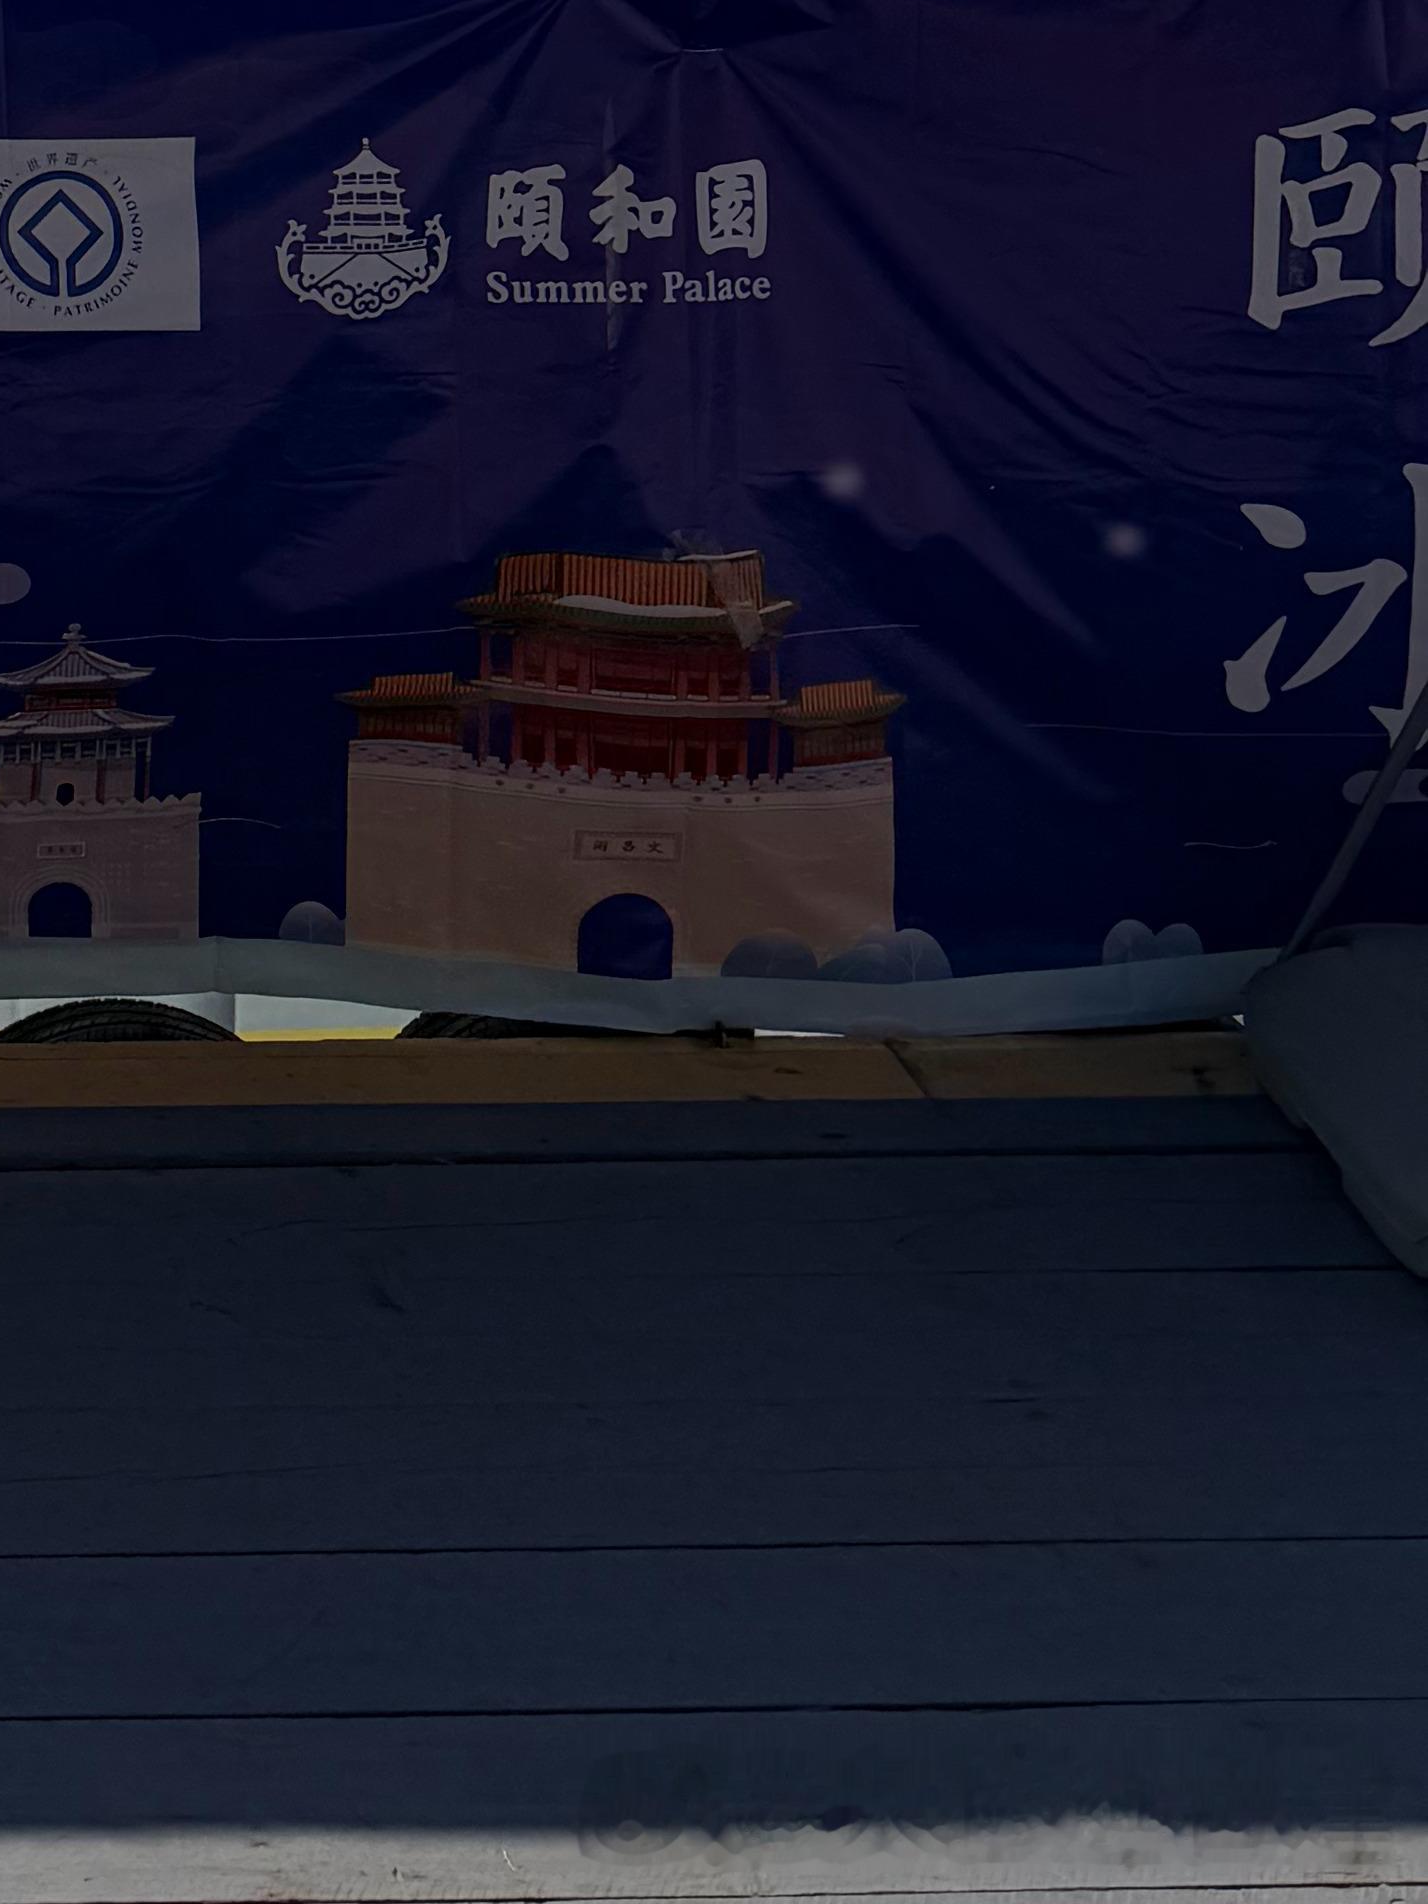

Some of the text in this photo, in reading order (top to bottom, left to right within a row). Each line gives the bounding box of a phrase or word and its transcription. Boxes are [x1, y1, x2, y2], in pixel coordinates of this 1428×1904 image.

[53, 175, 144, 317] PATRIMOINE MONDIAL
[486, 270, 772, 305] Summer Palace
